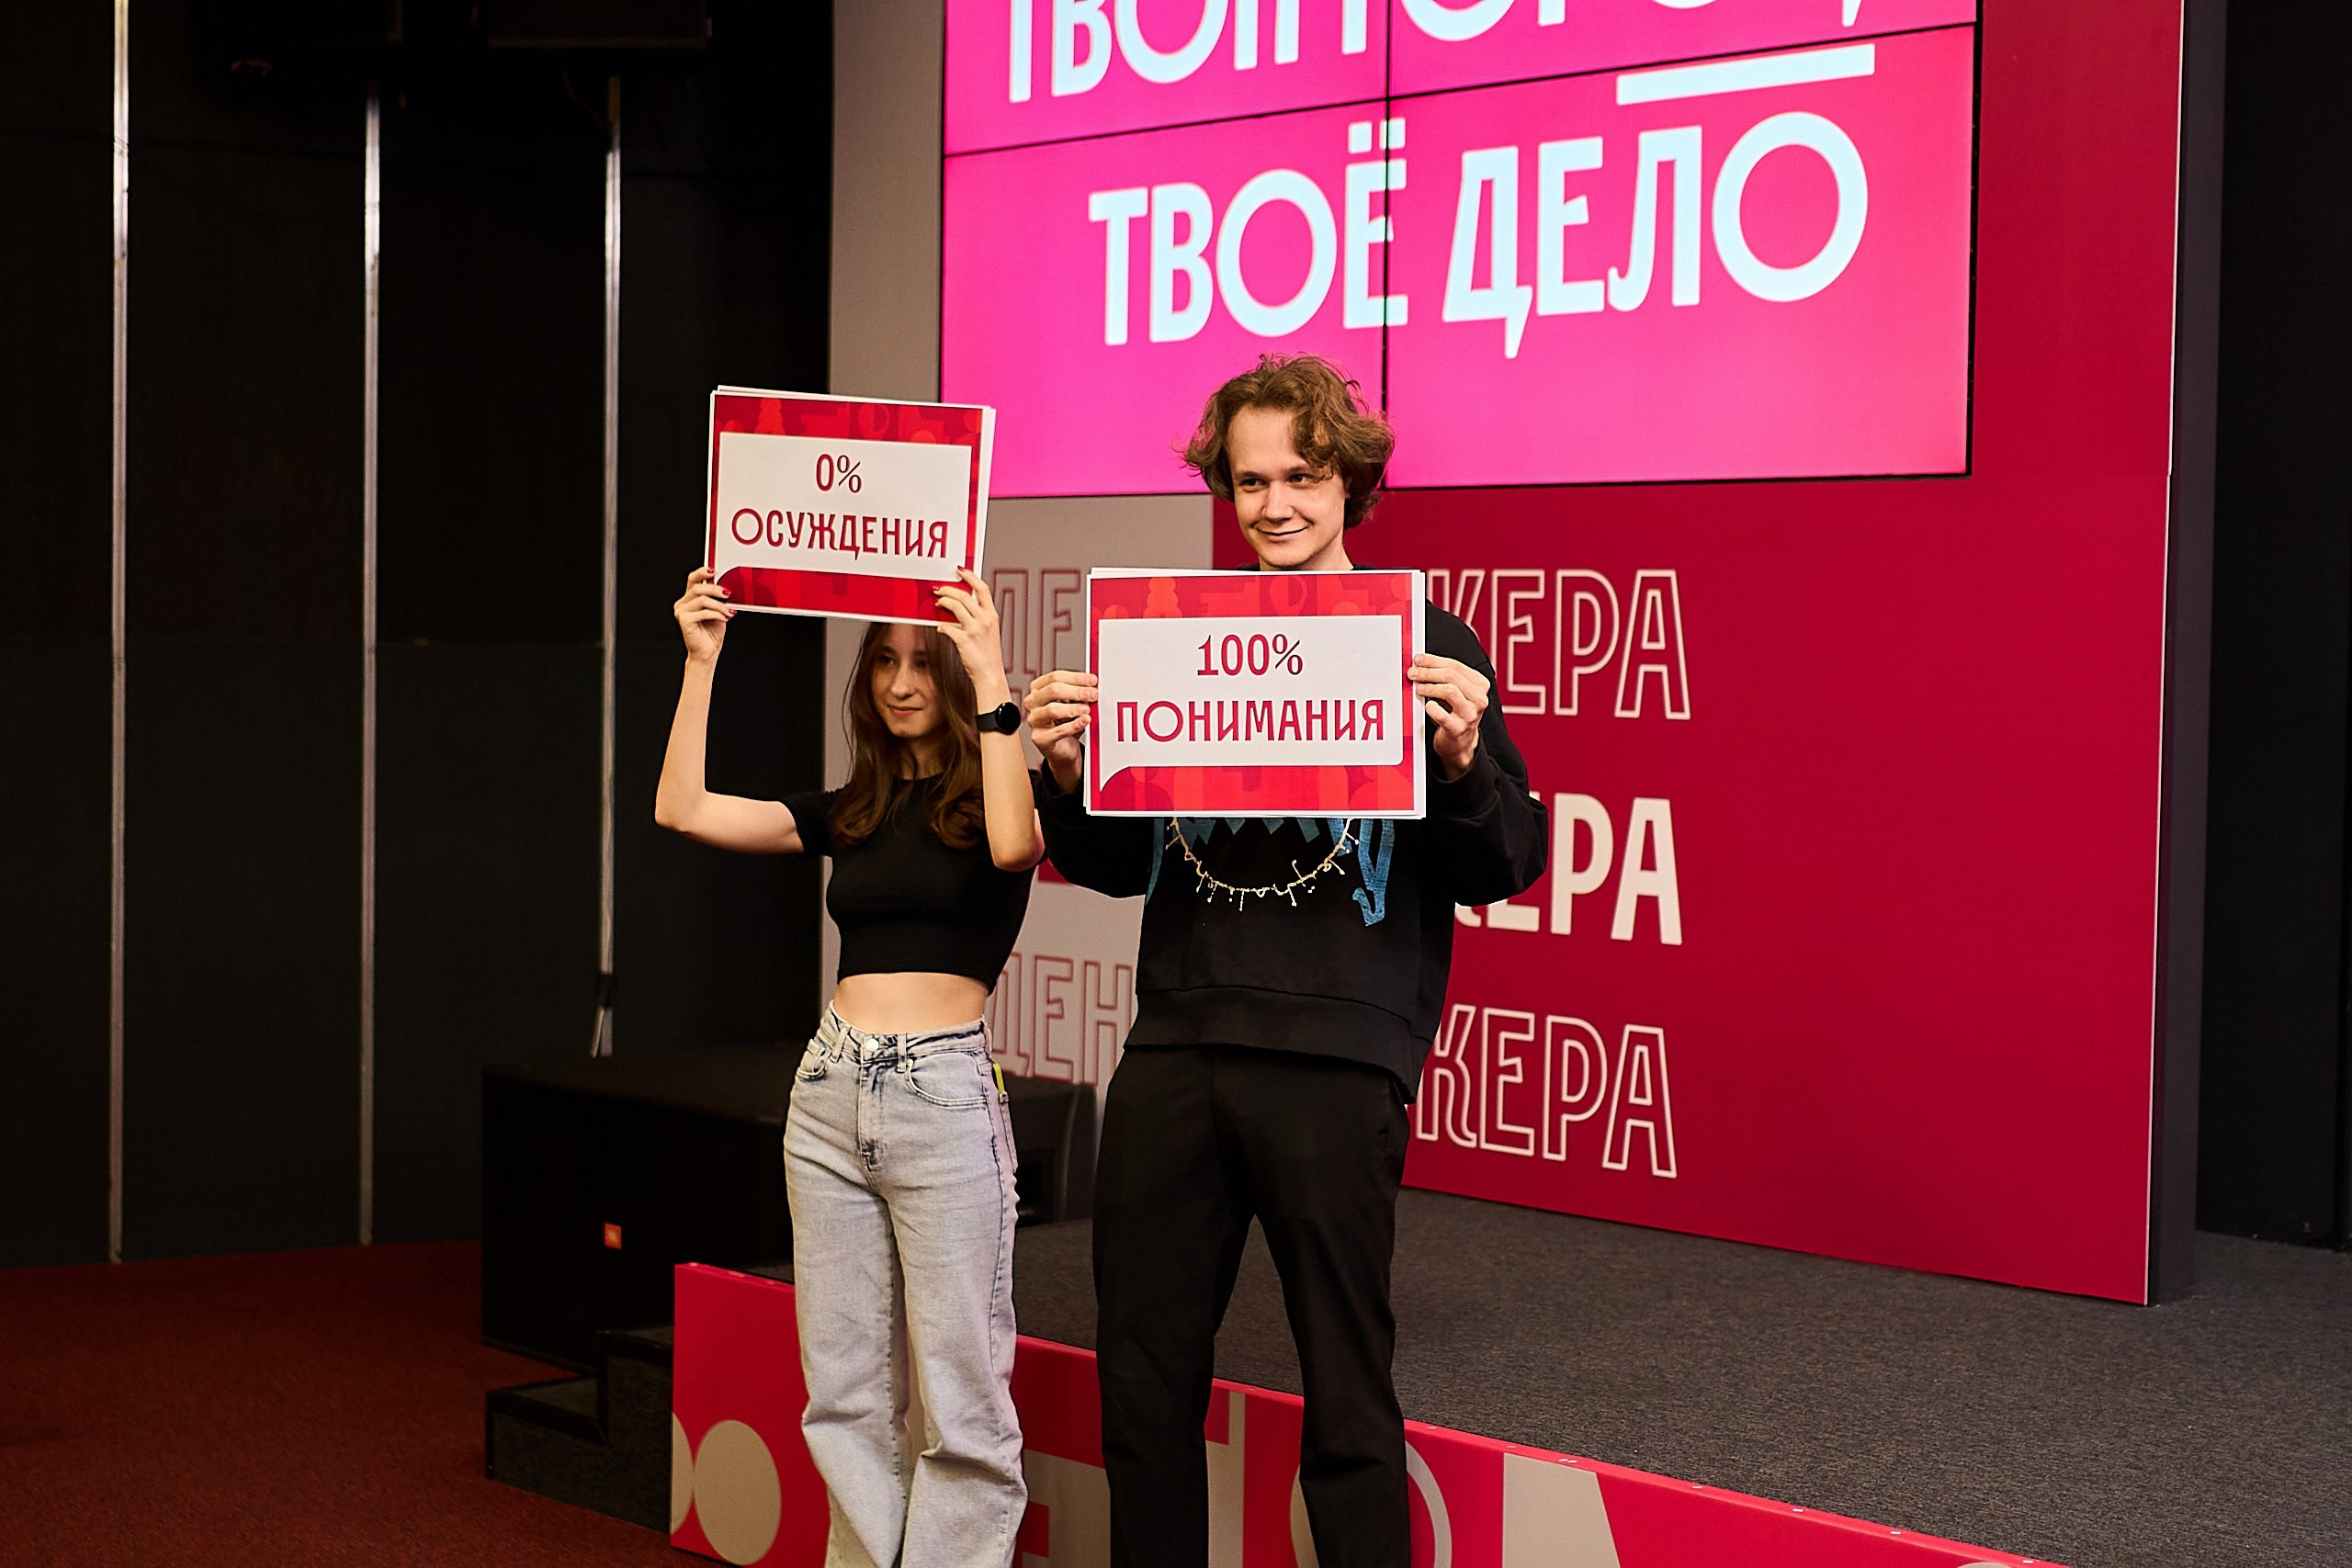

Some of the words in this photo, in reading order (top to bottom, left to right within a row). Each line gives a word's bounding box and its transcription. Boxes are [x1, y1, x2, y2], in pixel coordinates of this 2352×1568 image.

[1089, 119, 1408, 345] ТВОЁ
[1442, 111, 1869, 358] ДЕЛО
[816, 454, 862, 493] 0%
[731, 508, 948, 561] ОСУЖДЕНИЯ
[1197, 634, 1303, 675] 100%
[1116, 699, 1384, 742] ПОНИМАНИЯ
